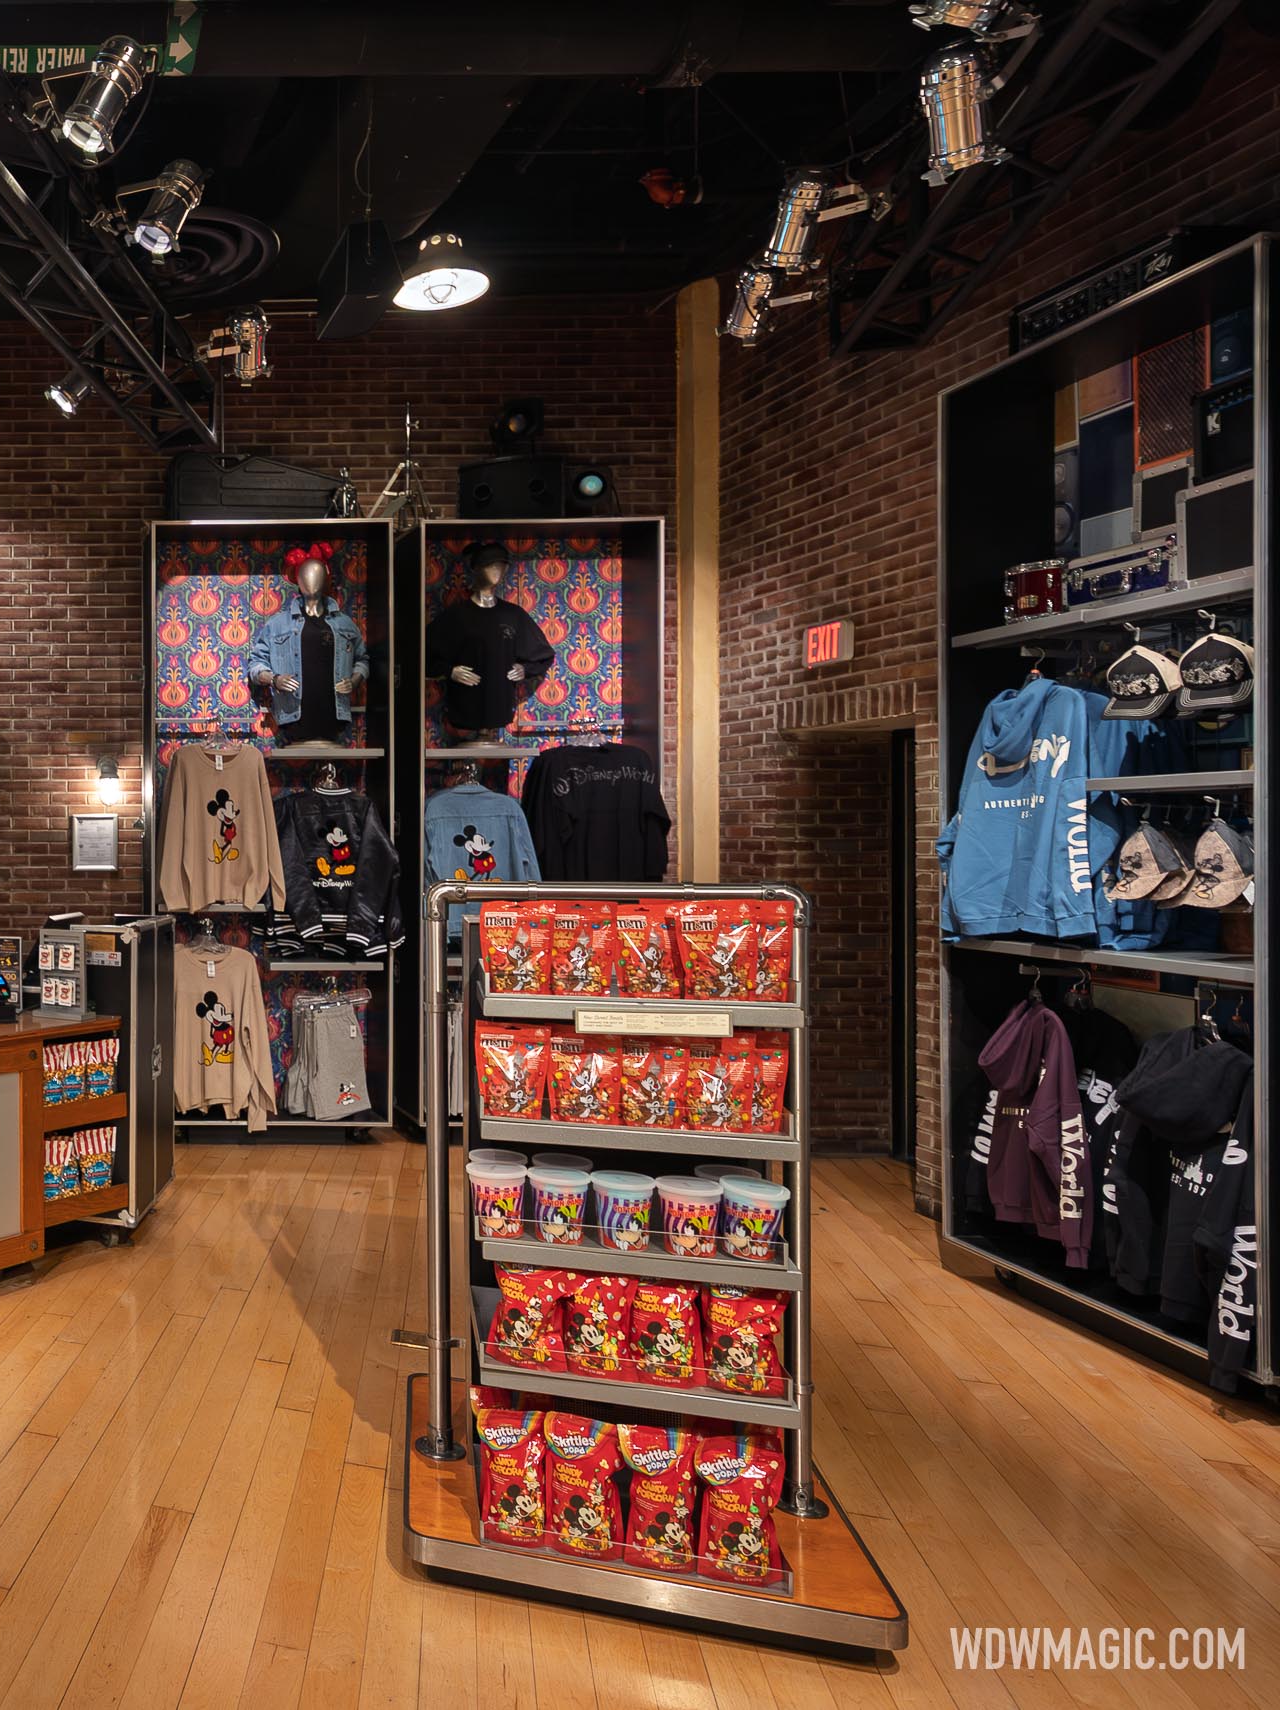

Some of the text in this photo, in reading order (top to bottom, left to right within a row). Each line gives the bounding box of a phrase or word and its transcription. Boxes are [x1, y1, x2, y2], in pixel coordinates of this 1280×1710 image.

[808, 622, 841, 663] EXIT
[1060, 1113, 1085, 1220] World
[1188, 1181, 1207, 1197] 197
[1219, 1225, 1257, 1341] World
[633, 1300, 667, 1314] OPCORN
[484, 1426, 529, 1441] Skittles
[553, 1434, 596, 1448] Skittles
[632, 1449, 677, 1467] Skittles
[700, 1456, 747, 1476] Skittles
[641, 1479, 669, 1495] CANDY
